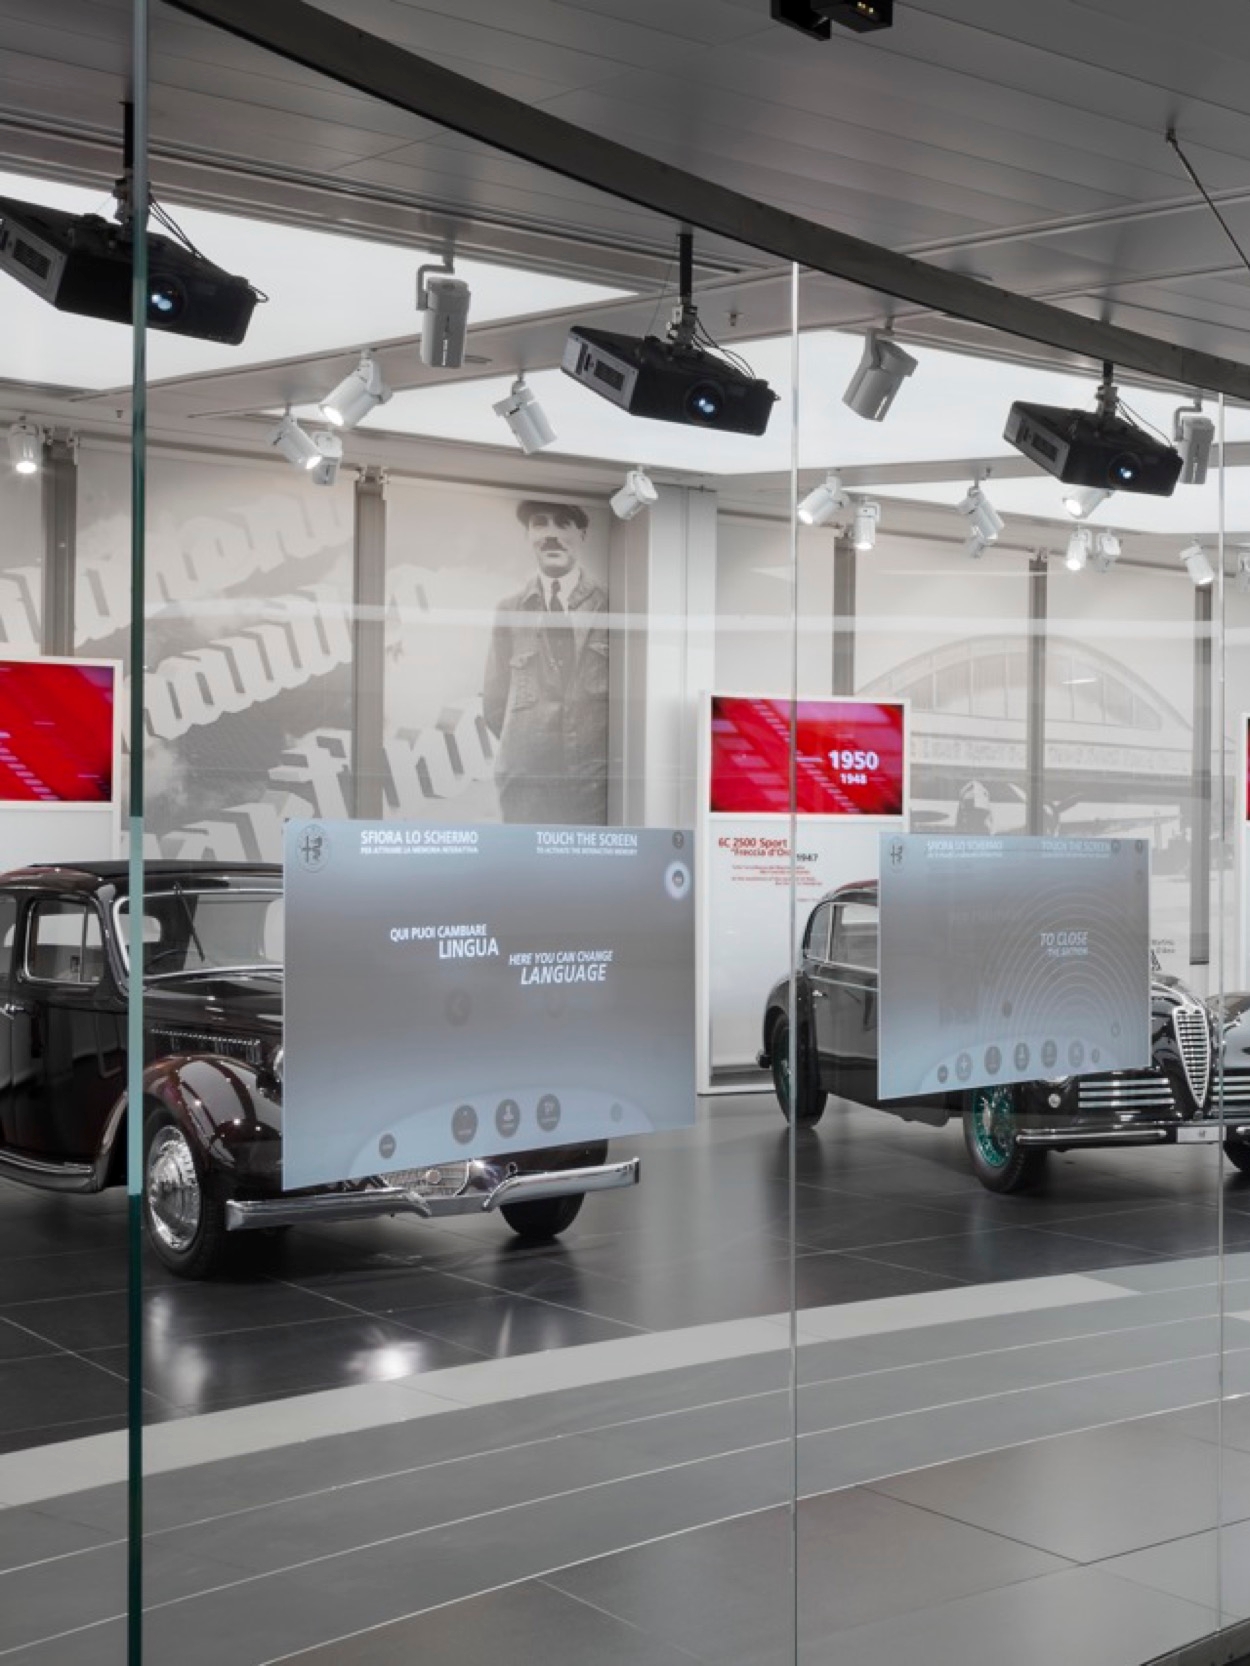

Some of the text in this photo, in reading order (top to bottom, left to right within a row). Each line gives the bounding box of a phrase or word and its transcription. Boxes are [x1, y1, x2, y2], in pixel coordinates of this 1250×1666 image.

[829, 750, 879, 770] 1950
[840, 773, 868, 785] 1948
[360, 830, 479, 845] SFIORA LO SCHERMO
[536, 831, 638, 847] TOUCH THE SCREEN
[733, 837, 757, 848] 2500
[759, 837, 788, 849] Sport
[390, 923, 488, 942] QUI PUOI CAMBIARE
[1040, 931, 1089, 947] TO CLOSE
[438, 937, 500, 960] LINGUA
[509, 950, 614, 966] HERE YOU CAN CHANGE
[520, 963, 608, 985] LANGUAGE
